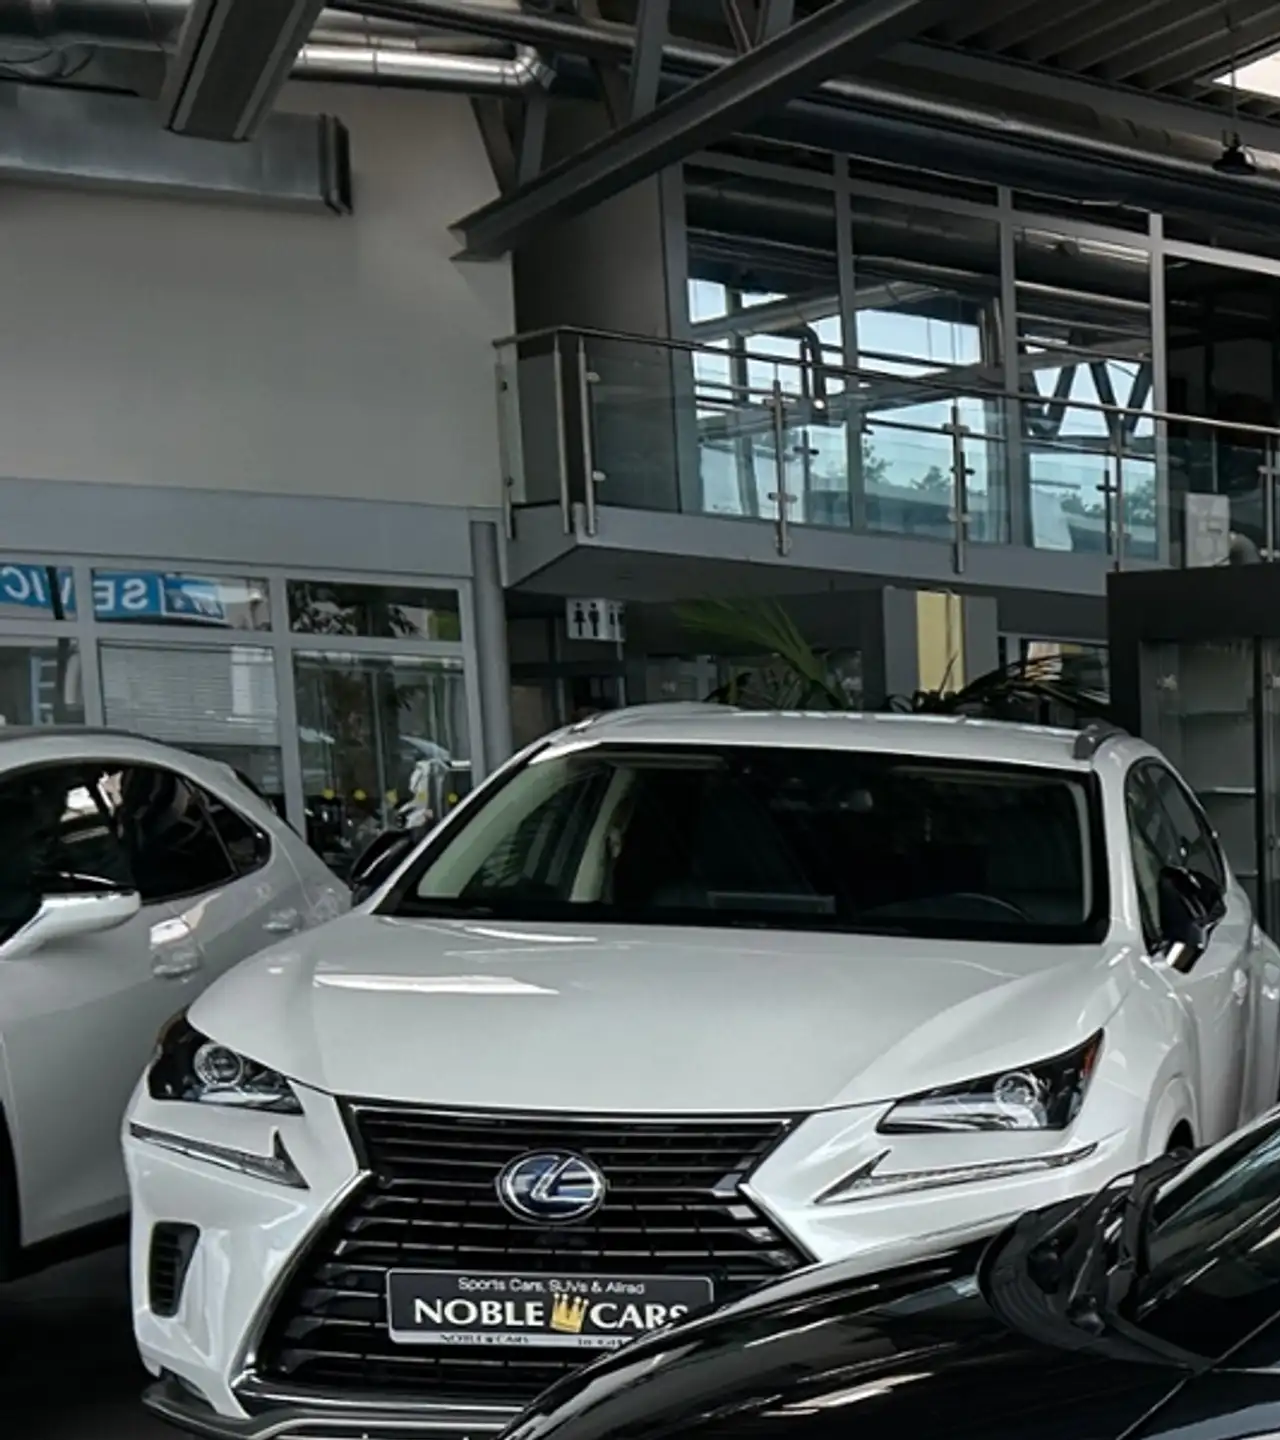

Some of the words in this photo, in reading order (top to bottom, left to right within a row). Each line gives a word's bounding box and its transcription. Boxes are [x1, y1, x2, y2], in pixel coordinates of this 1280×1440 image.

[457, 1277, 506, 1292] Sports
[549, 1280, 588, 1293] SUVs
[590, 1281, 603, 1293] &
[605, 1282, 646, 1295] Allrad
[413, 1297, 545, 1328] NOBLE
